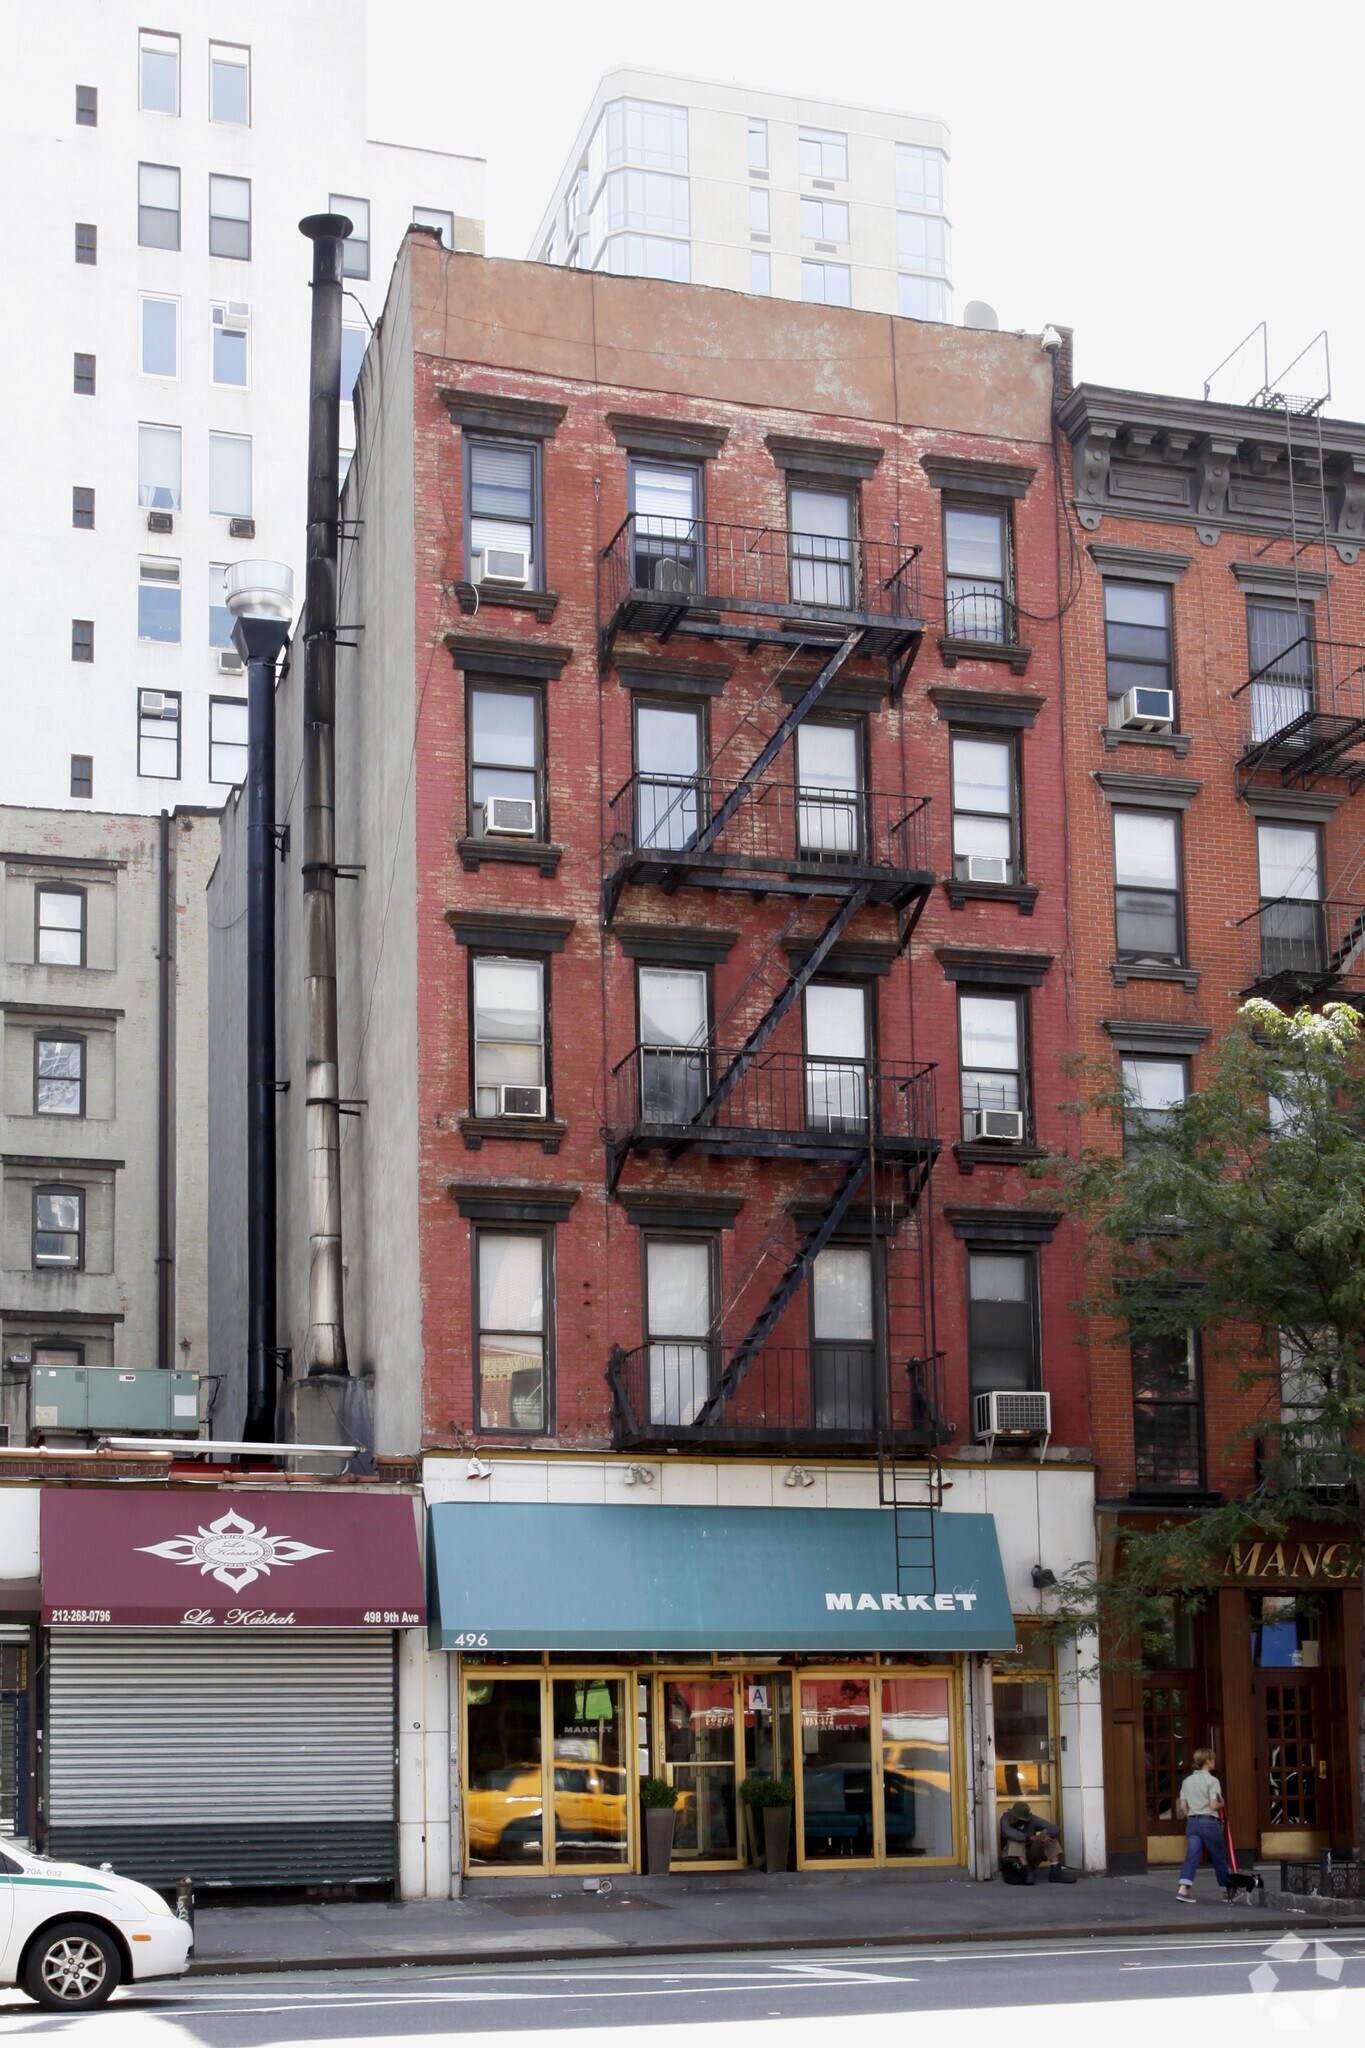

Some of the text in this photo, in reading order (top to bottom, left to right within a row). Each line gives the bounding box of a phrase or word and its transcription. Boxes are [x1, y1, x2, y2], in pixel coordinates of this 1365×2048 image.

[222, 1540, 245, 1548] La
[208, 1548, 259, 1556] Kasbah
[825, 1593, 977, 1611] MARKET
[52, 1610, 111, 1622] 212-268-0796
[180, 1608, 296, 1625] La Kasbah
[363, 1611, 419, 1623] 498 9th Ave
[454, 1633, 488, 1647] 496
[752, 1689, 764, 1703] A
